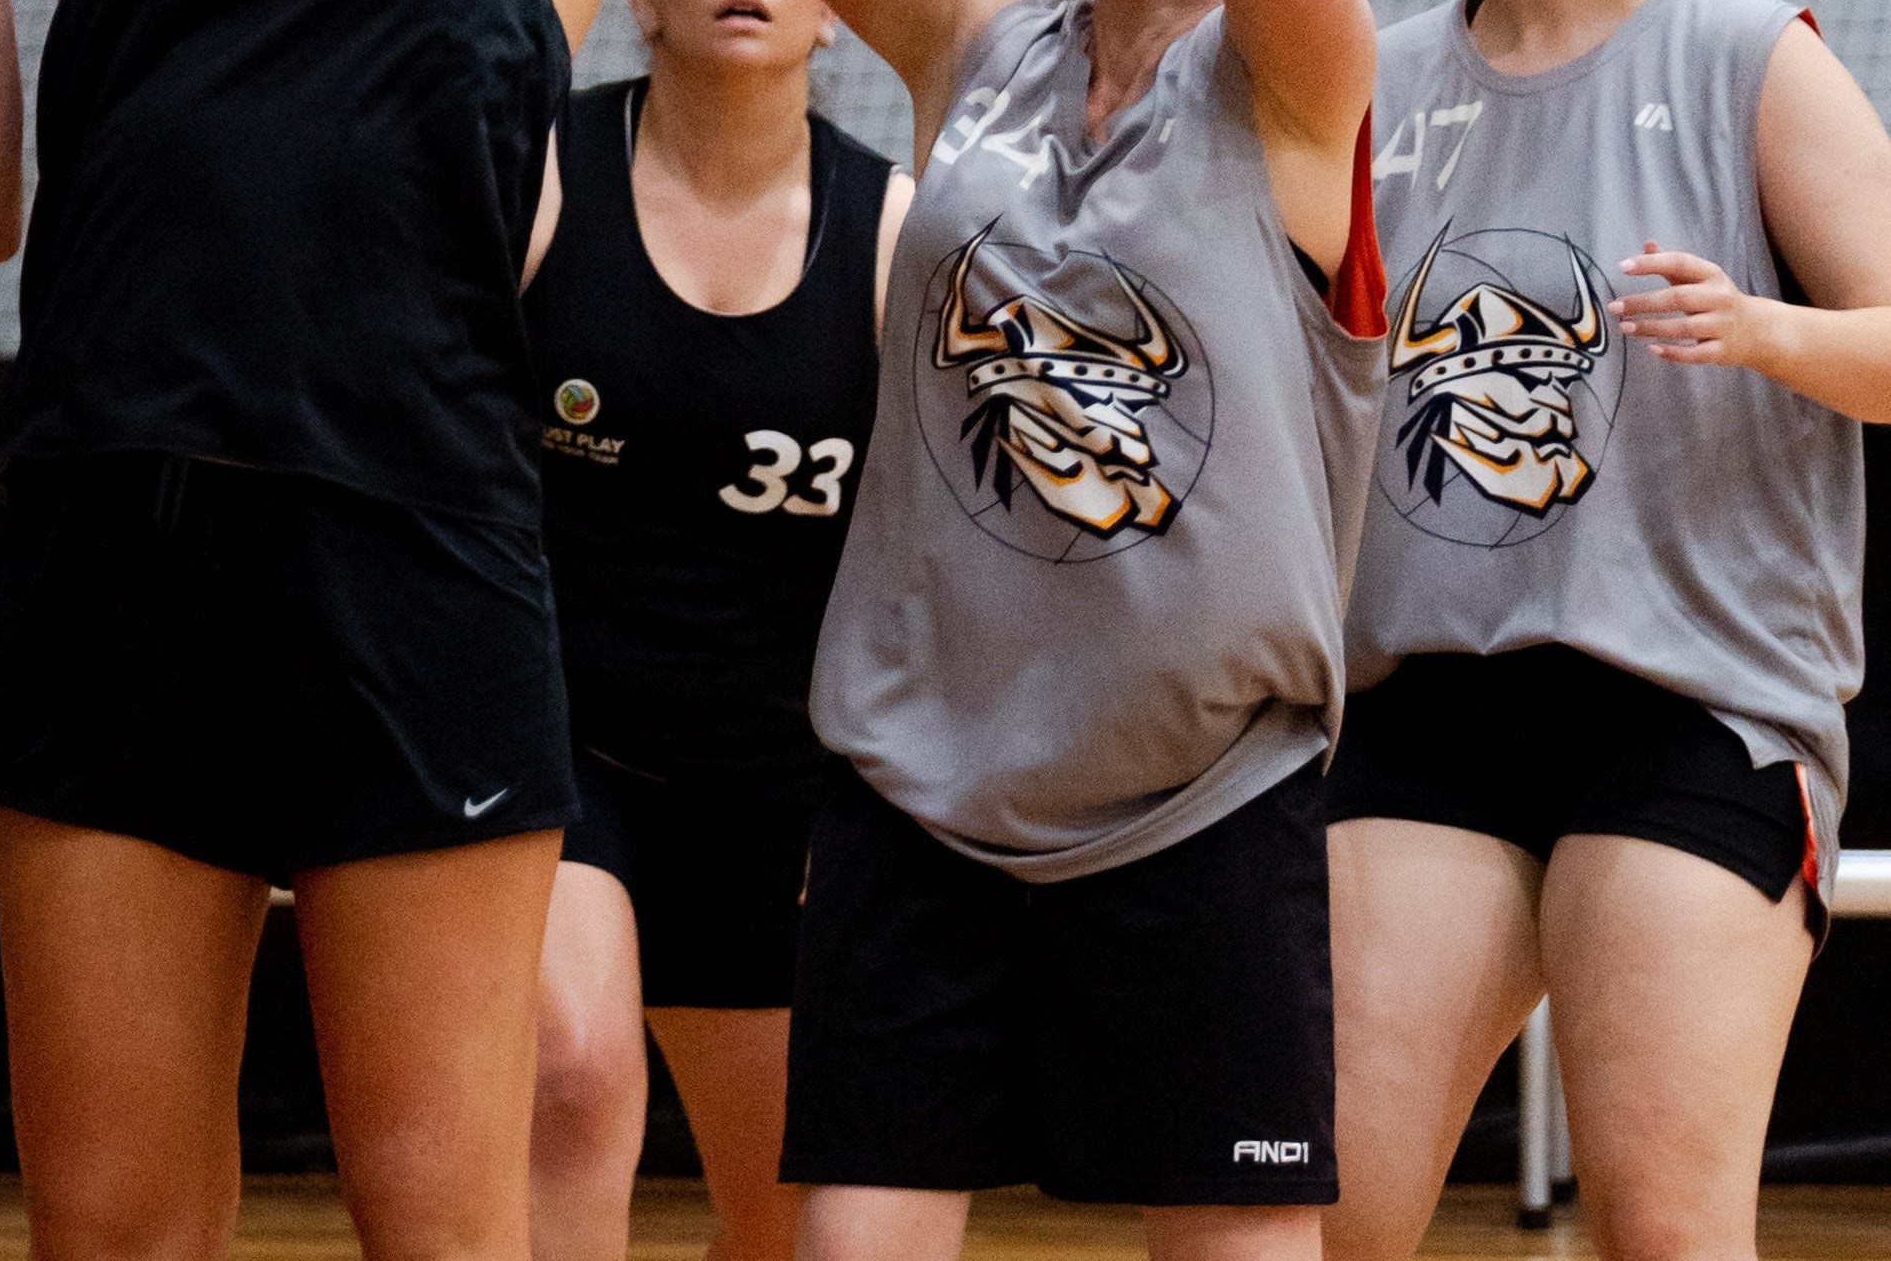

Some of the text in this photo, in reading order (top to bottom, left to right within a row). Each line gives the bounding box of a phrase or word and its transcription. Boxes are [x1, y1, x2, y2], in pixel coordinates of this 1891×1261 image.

[1372, 99, 1483, 191] 47
[576, 432, 626, 455] PLAY
[718, 429, 854, 516] 33
[1233, 1141, 1309, 1164] AND1
